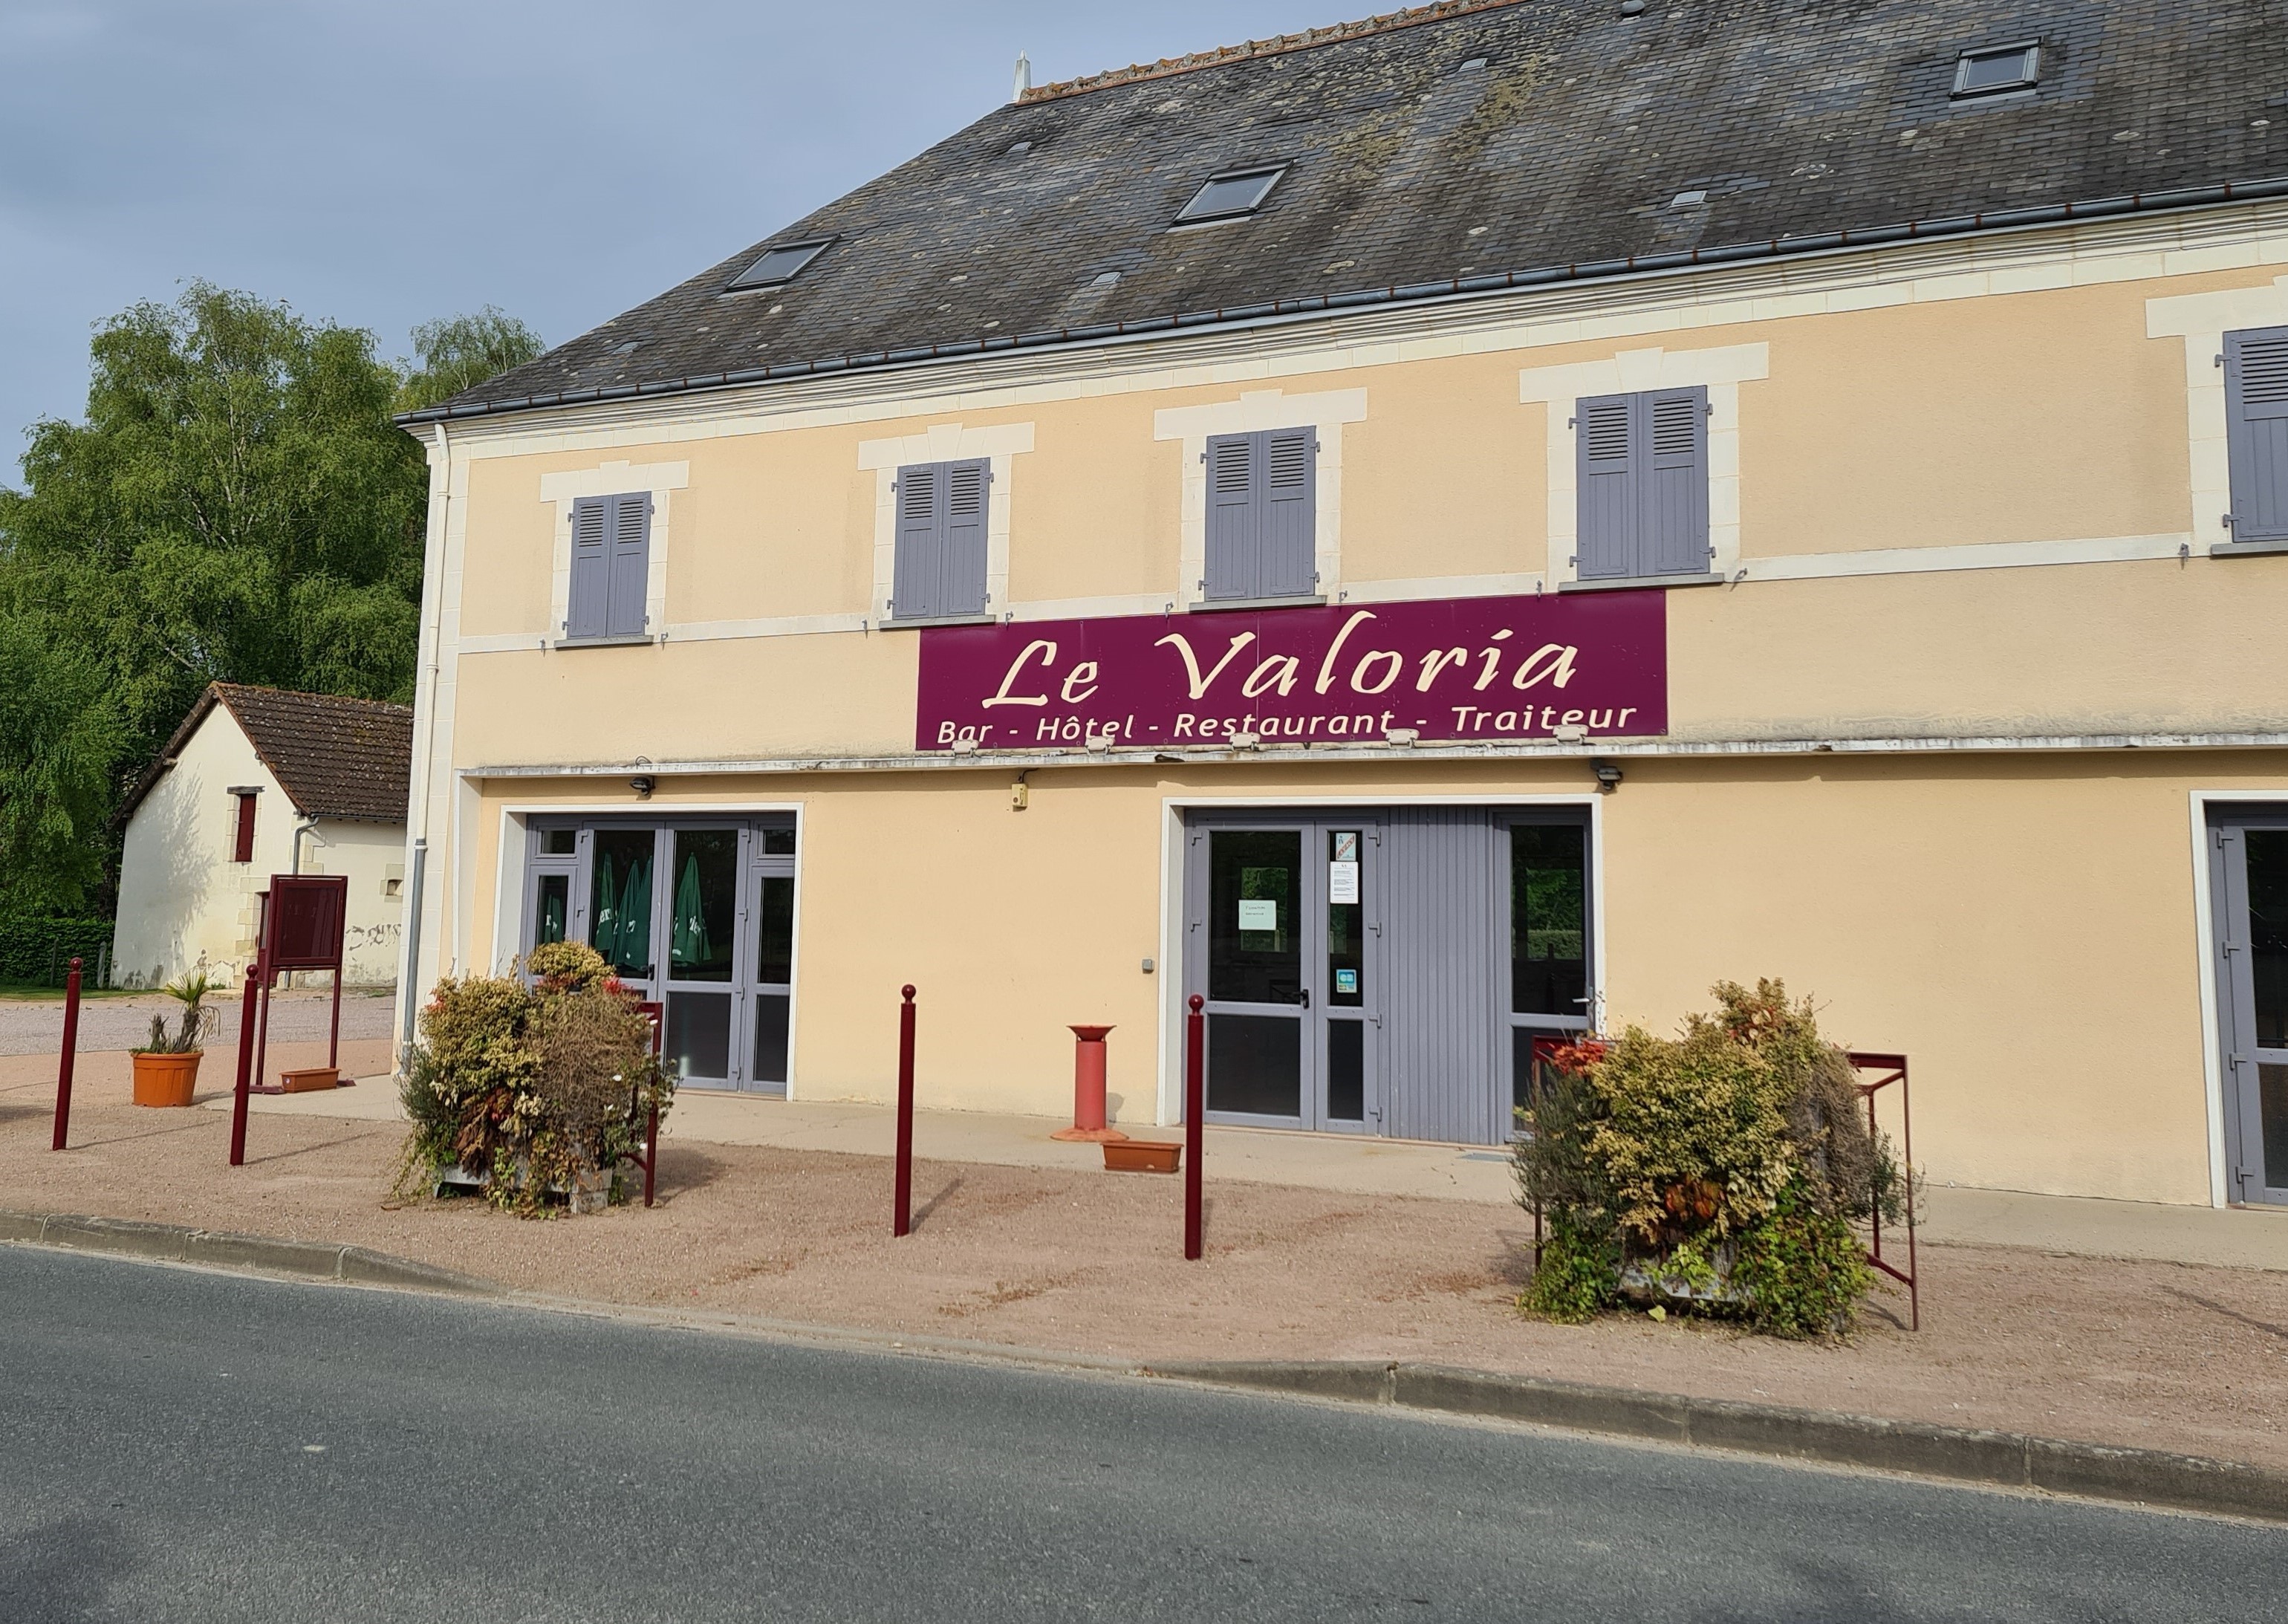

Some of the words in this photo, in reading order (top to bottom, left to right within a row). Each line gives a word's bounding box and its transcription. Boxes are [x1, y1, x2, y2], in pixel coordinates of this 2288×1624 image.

[981, 640, 1099, 709] Le
[1154, 610, 1578, 700] Valoria
[937, 721, 993, 744] Bar
[1036, 714, 1134, 741] Hôtel
[1174, 710, 1395, 737] Restaurant
[1451, 704, 1637, 732] Traiteur
